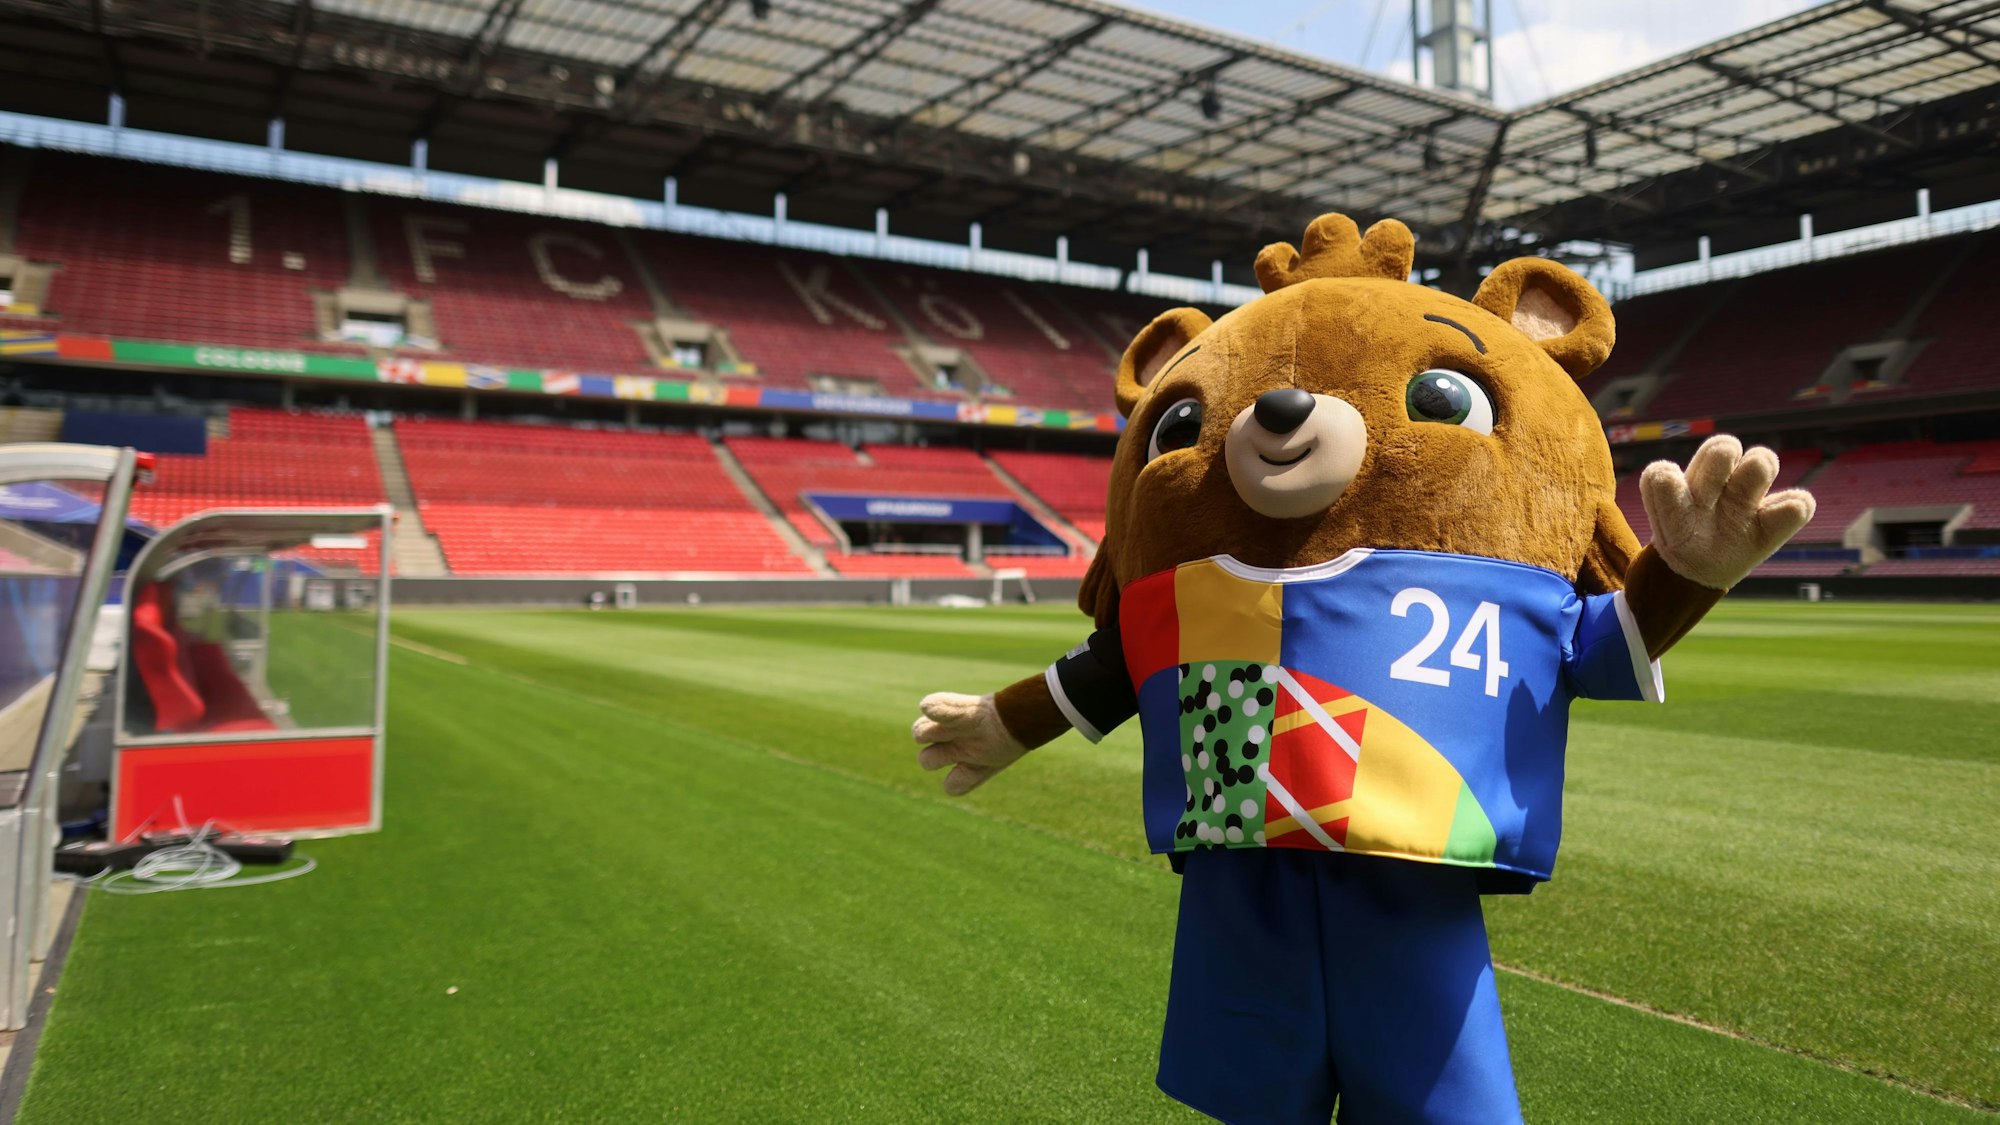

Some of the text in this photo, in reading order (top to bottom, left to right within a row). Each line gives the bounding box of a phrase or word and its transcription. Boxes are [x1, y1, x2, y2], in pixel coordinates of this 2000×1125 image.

[207, 195, 306, 270] 1.
[195, 346, 306, 373] COLOGNE
[1390, 587, 1509, 698] 24
